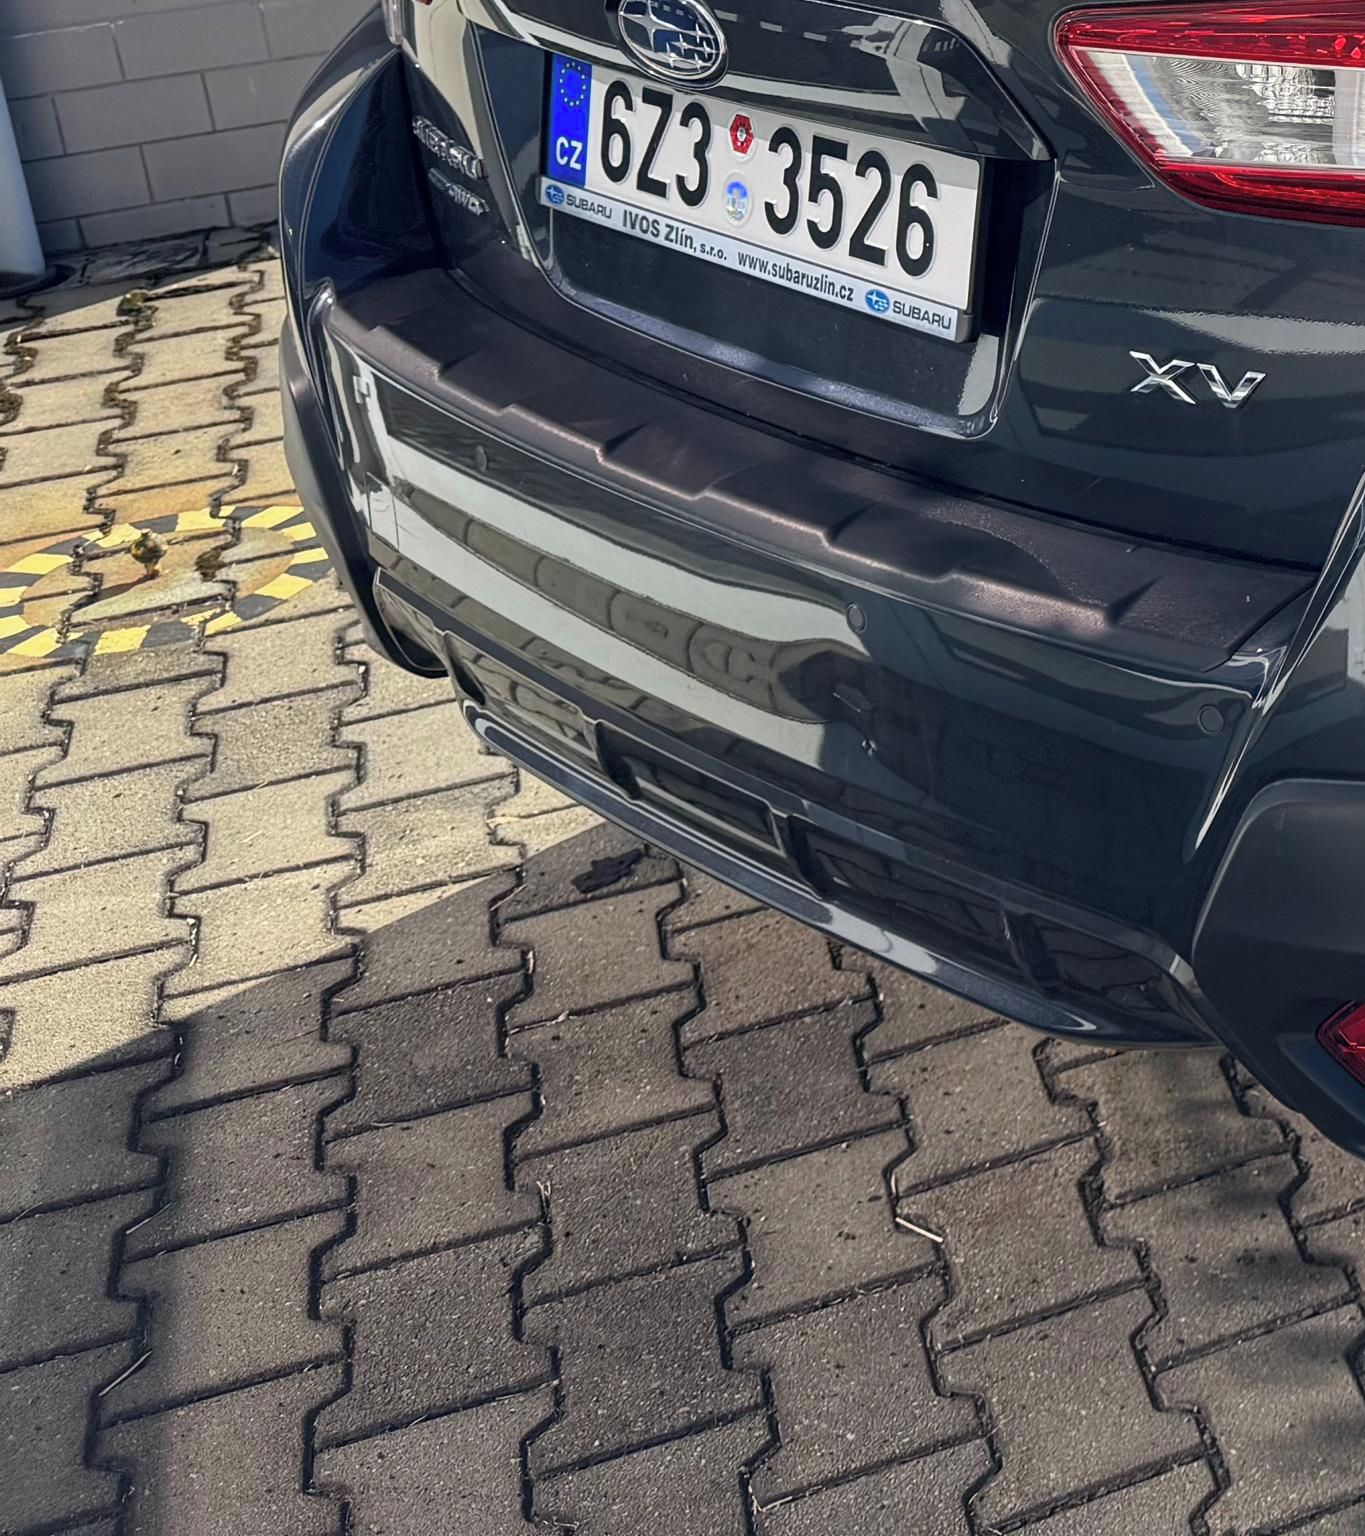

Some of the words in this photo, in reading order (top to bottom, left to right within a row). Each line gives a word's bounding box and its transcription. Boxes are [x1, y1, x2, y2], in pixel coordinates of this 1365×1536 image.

[556, 136, 583, 170] CZ
[601, 80, 711, 207] 6Z3
[764, 126, 938, 277] 3526
[566, 193, 613, 219] SUBARU
[622, 209, 661, 239] IVOS
[664, 223, 697, 254] Zlín,
[699, 242, 728, 261] s.r.o.
[738, 251, 855, 303] www.subaruzlin.cz
[892, 301, 953, 330] SUBARU
[1129, 350, 1268, 409] XV
